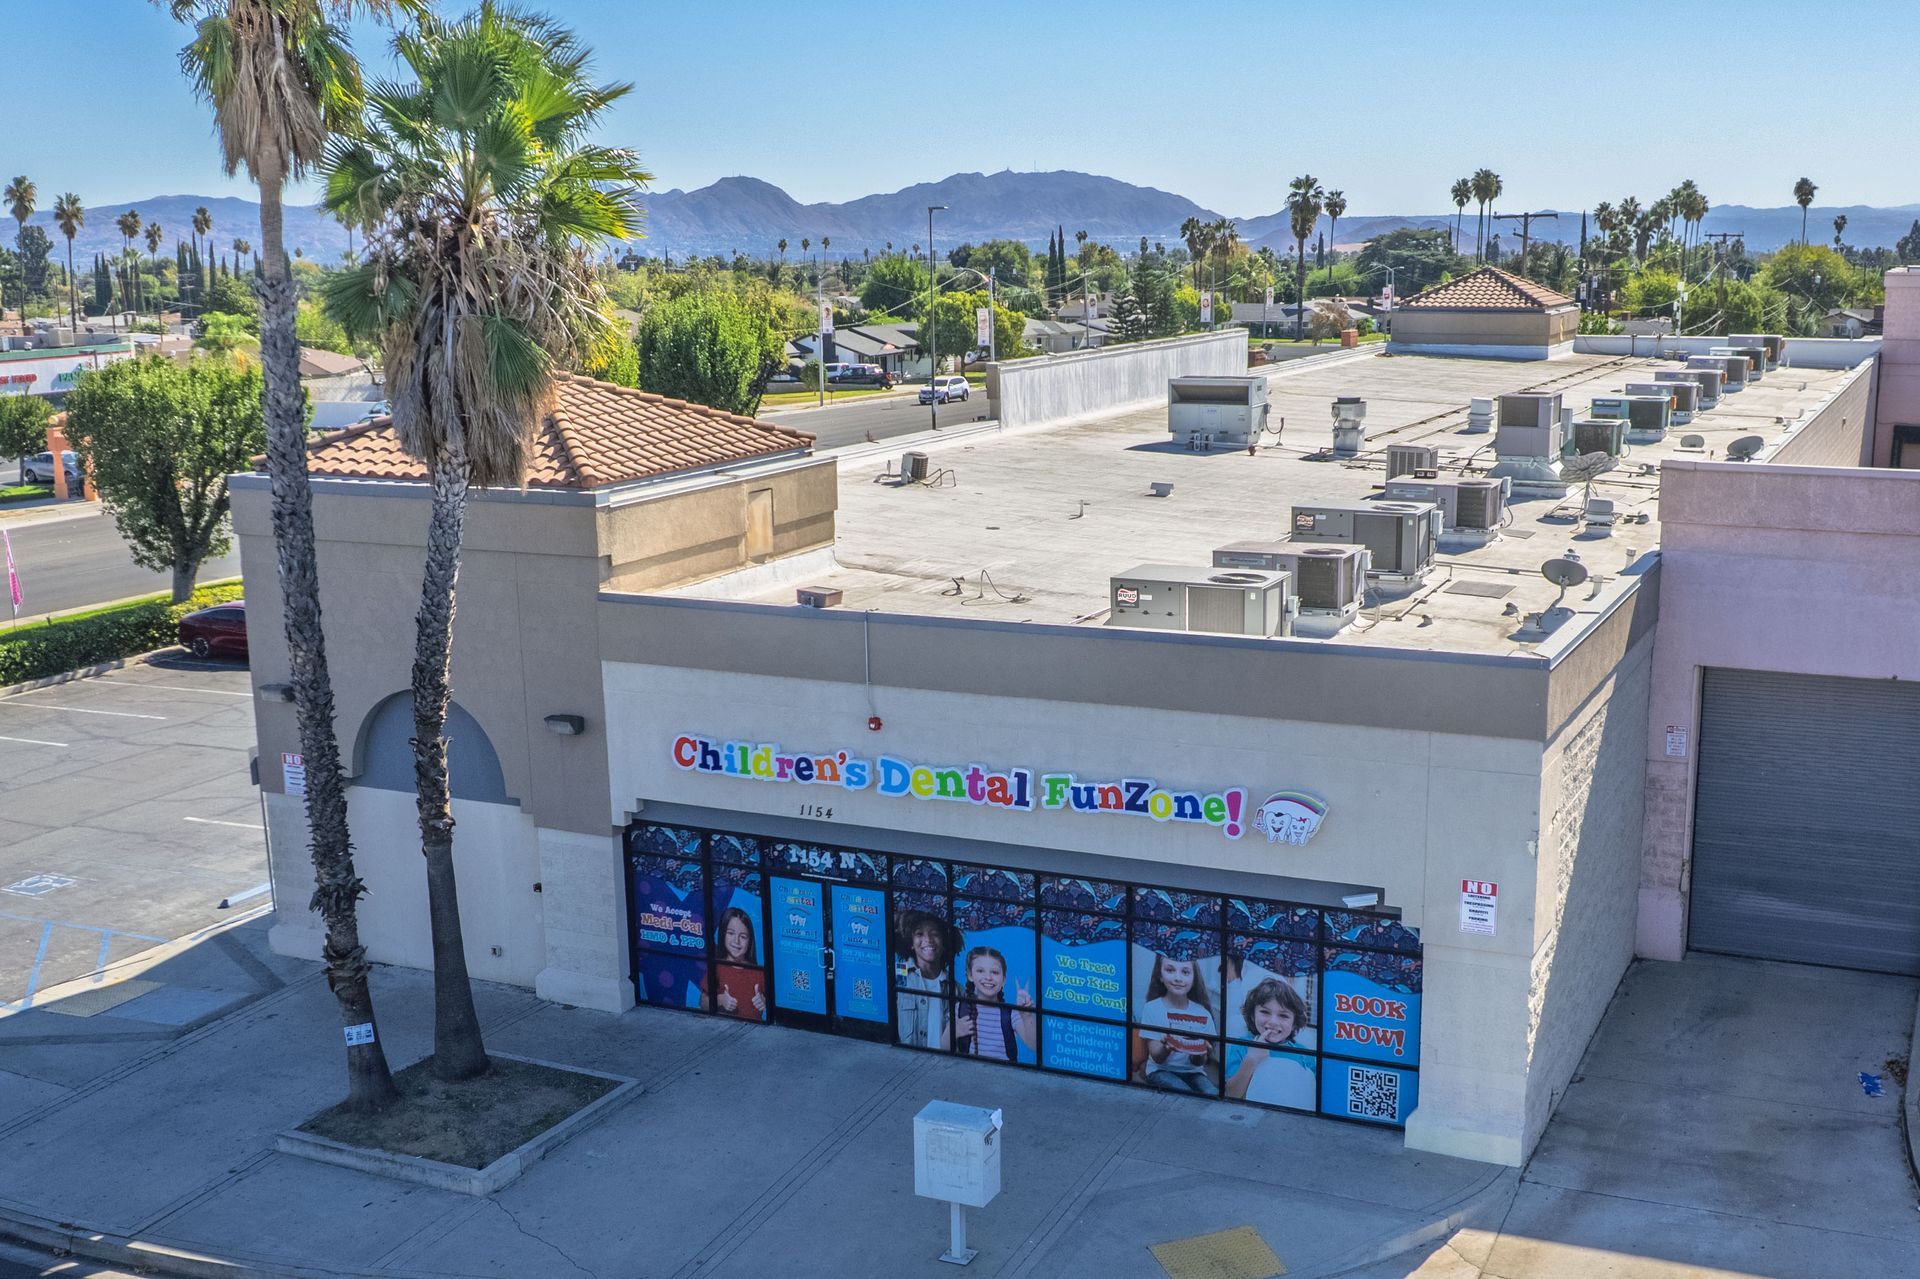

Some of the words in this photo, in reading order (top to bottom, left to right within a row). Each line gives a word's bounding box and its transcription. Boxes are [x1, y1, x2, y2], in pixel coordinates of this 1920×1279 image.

[674, 736, 867, 787] Children's
[880, 758, 1030, 807] Dental
[1044, 777, 1243, 837] FunZone!
[800, 804, 833, 819] 1154
[789, 847, 834, 869] 1154
[840, 852, 856, 869] N
[1467, 881, 1492, 894] NO
[650, 904, 663, 913] We
[666, 907, 692, 919] Accept
[641, 913, 703, 936] Medi-Cal
[640, 929, 667, 943] HMO
[669, 934, 679, 945] &
[680, 935, 704, 949] PPO
[1056, 955, 1077, 969] We
[1079, 959, 1115, 976] Treat
[1053, 971, 1085, 986] Your
[1087, 976, 1119, 992] Kids
[1046, 987, 1062, 999] As
[1065, 989, 1090, 1003] Our
[1092, 994, 1127, 1013] Own!
[1335, 994, 1407, 1021] BOOK
[1047, 1016, 1064, 1029] We
[1067, 1021, 1124, 1039] Specialize
[1065, 1032, 1119, 1050] Children's
[1335, 1021, 1405, 1056] NOW!
[1057, 1044, 1103, 1062] Dentistry
[1107, 1053, 1114, 1062] &
[1050, 1055, 1120, 1075] Orthodontics
